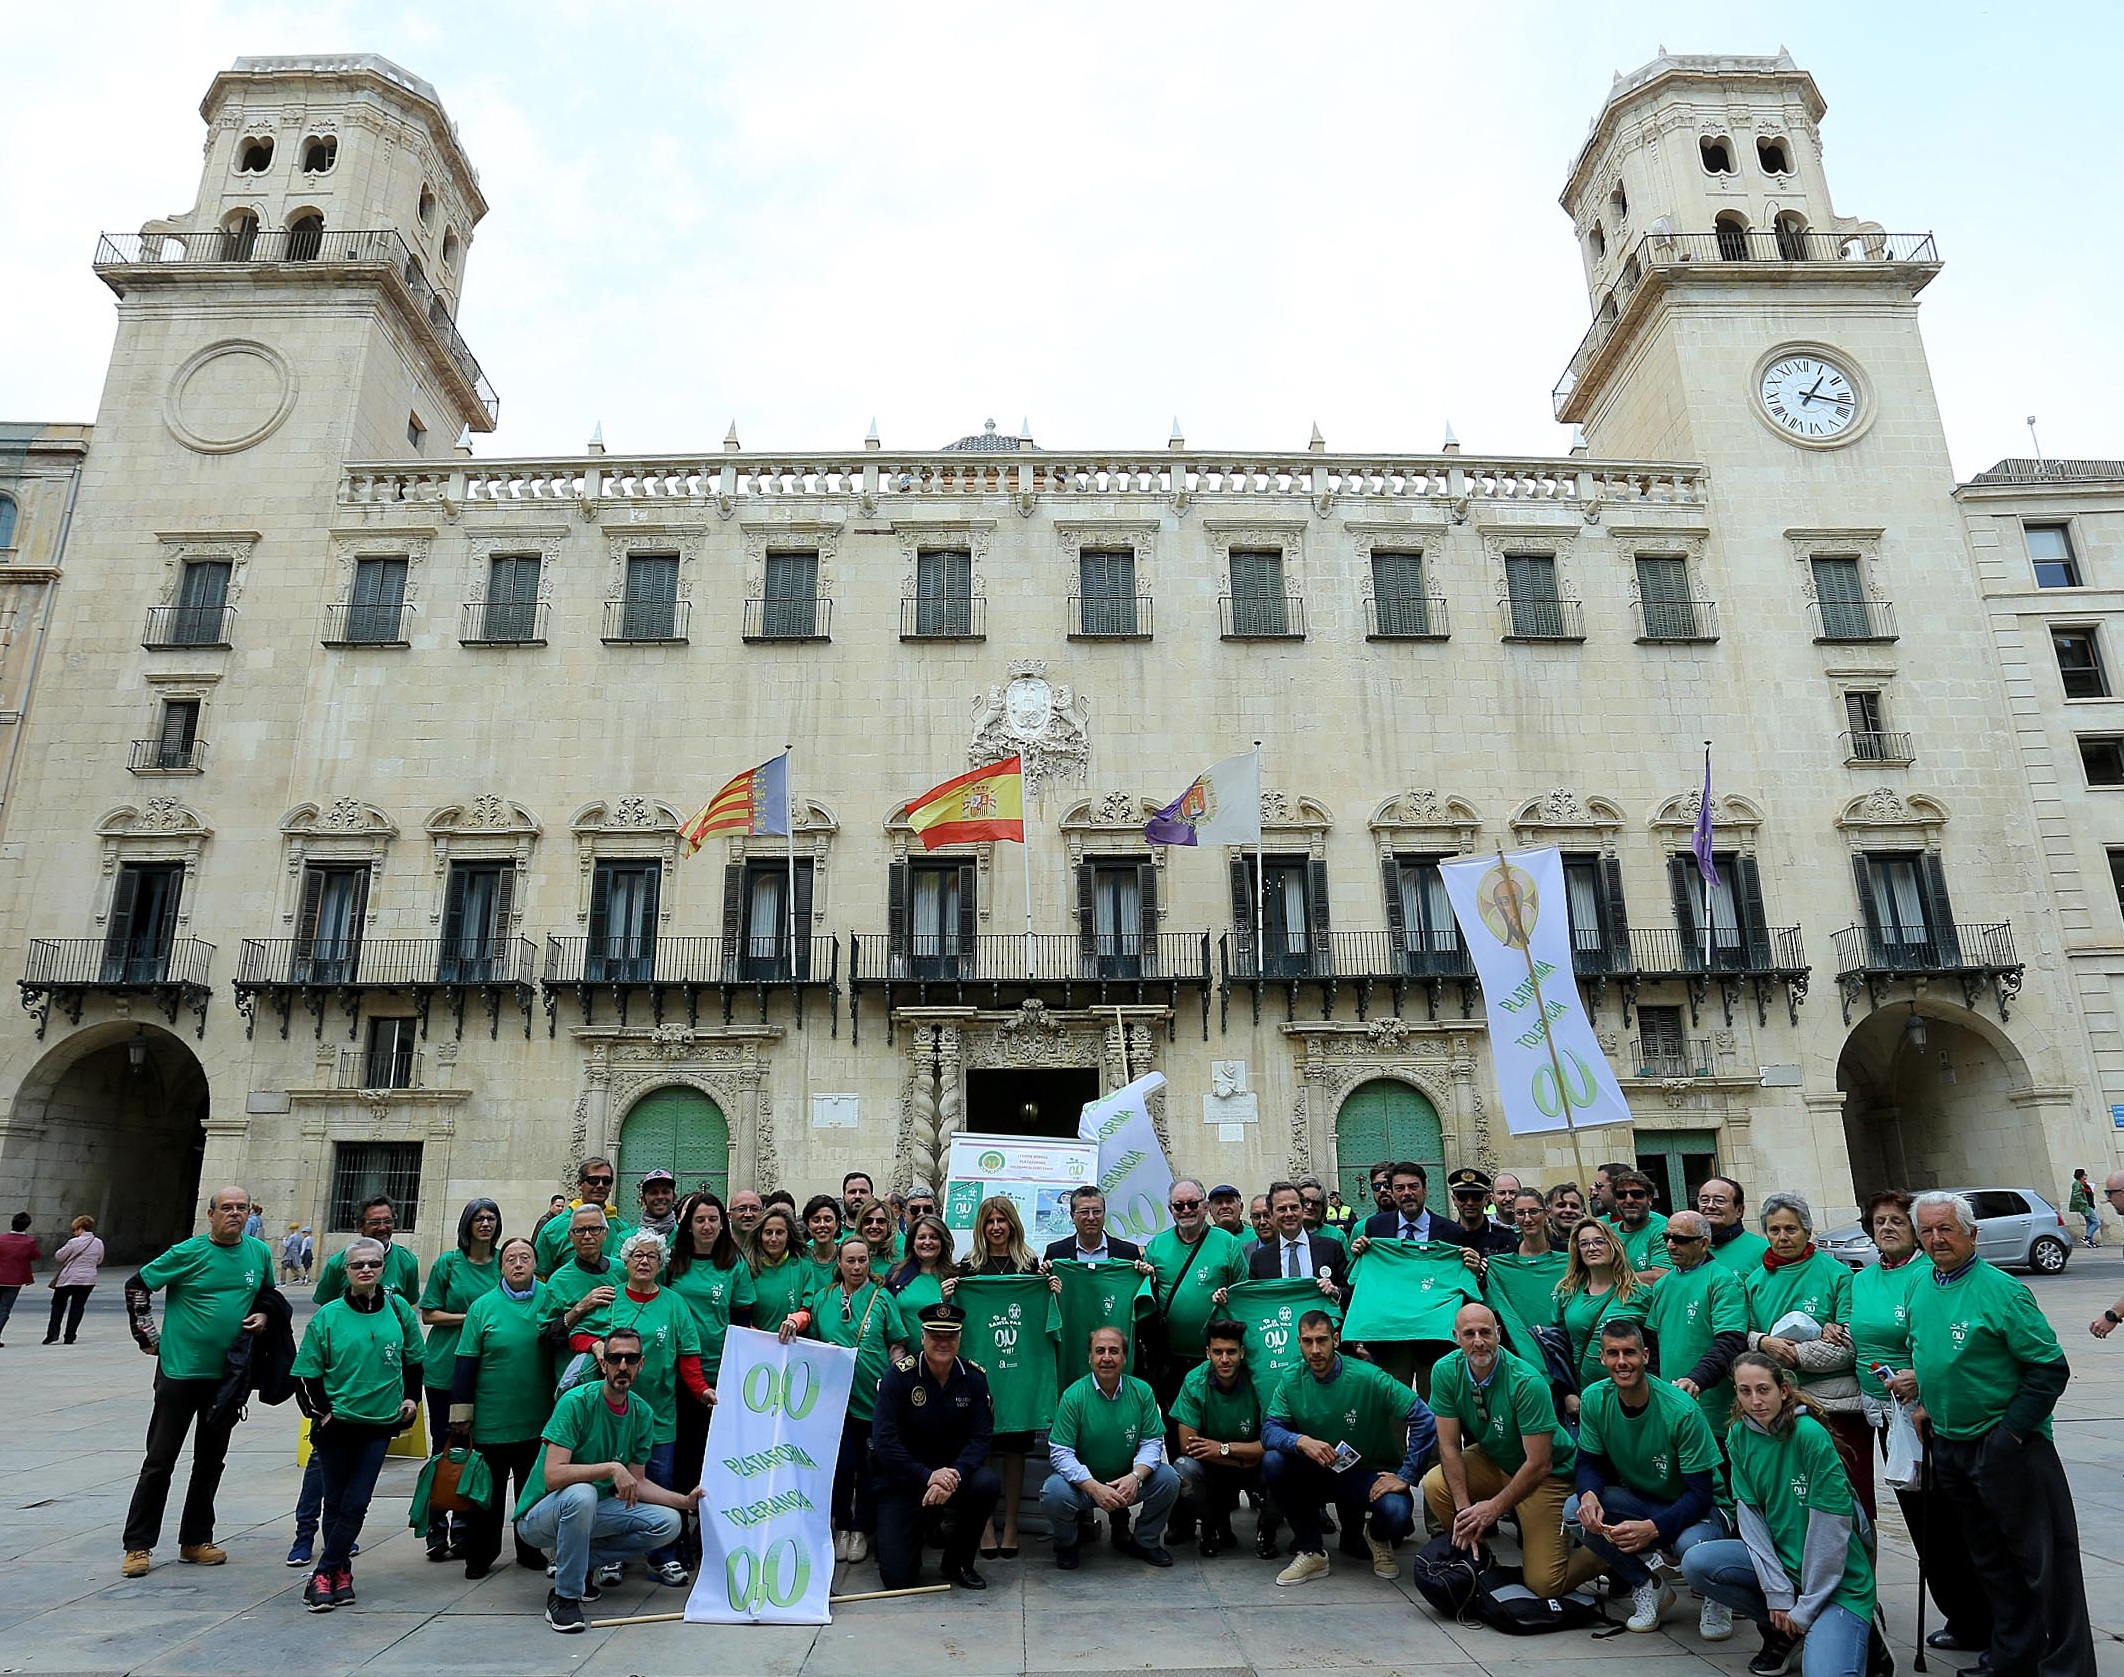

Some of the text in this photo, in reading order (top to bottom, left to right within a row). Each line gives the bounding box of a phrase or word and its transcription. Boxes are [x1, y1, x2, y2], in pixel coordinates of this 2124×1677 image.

[1793, 361, 1809, 373] XII
[743, 1357, 821, 1420] 0,0
[726, 1535, 811, 1615] 0,0
